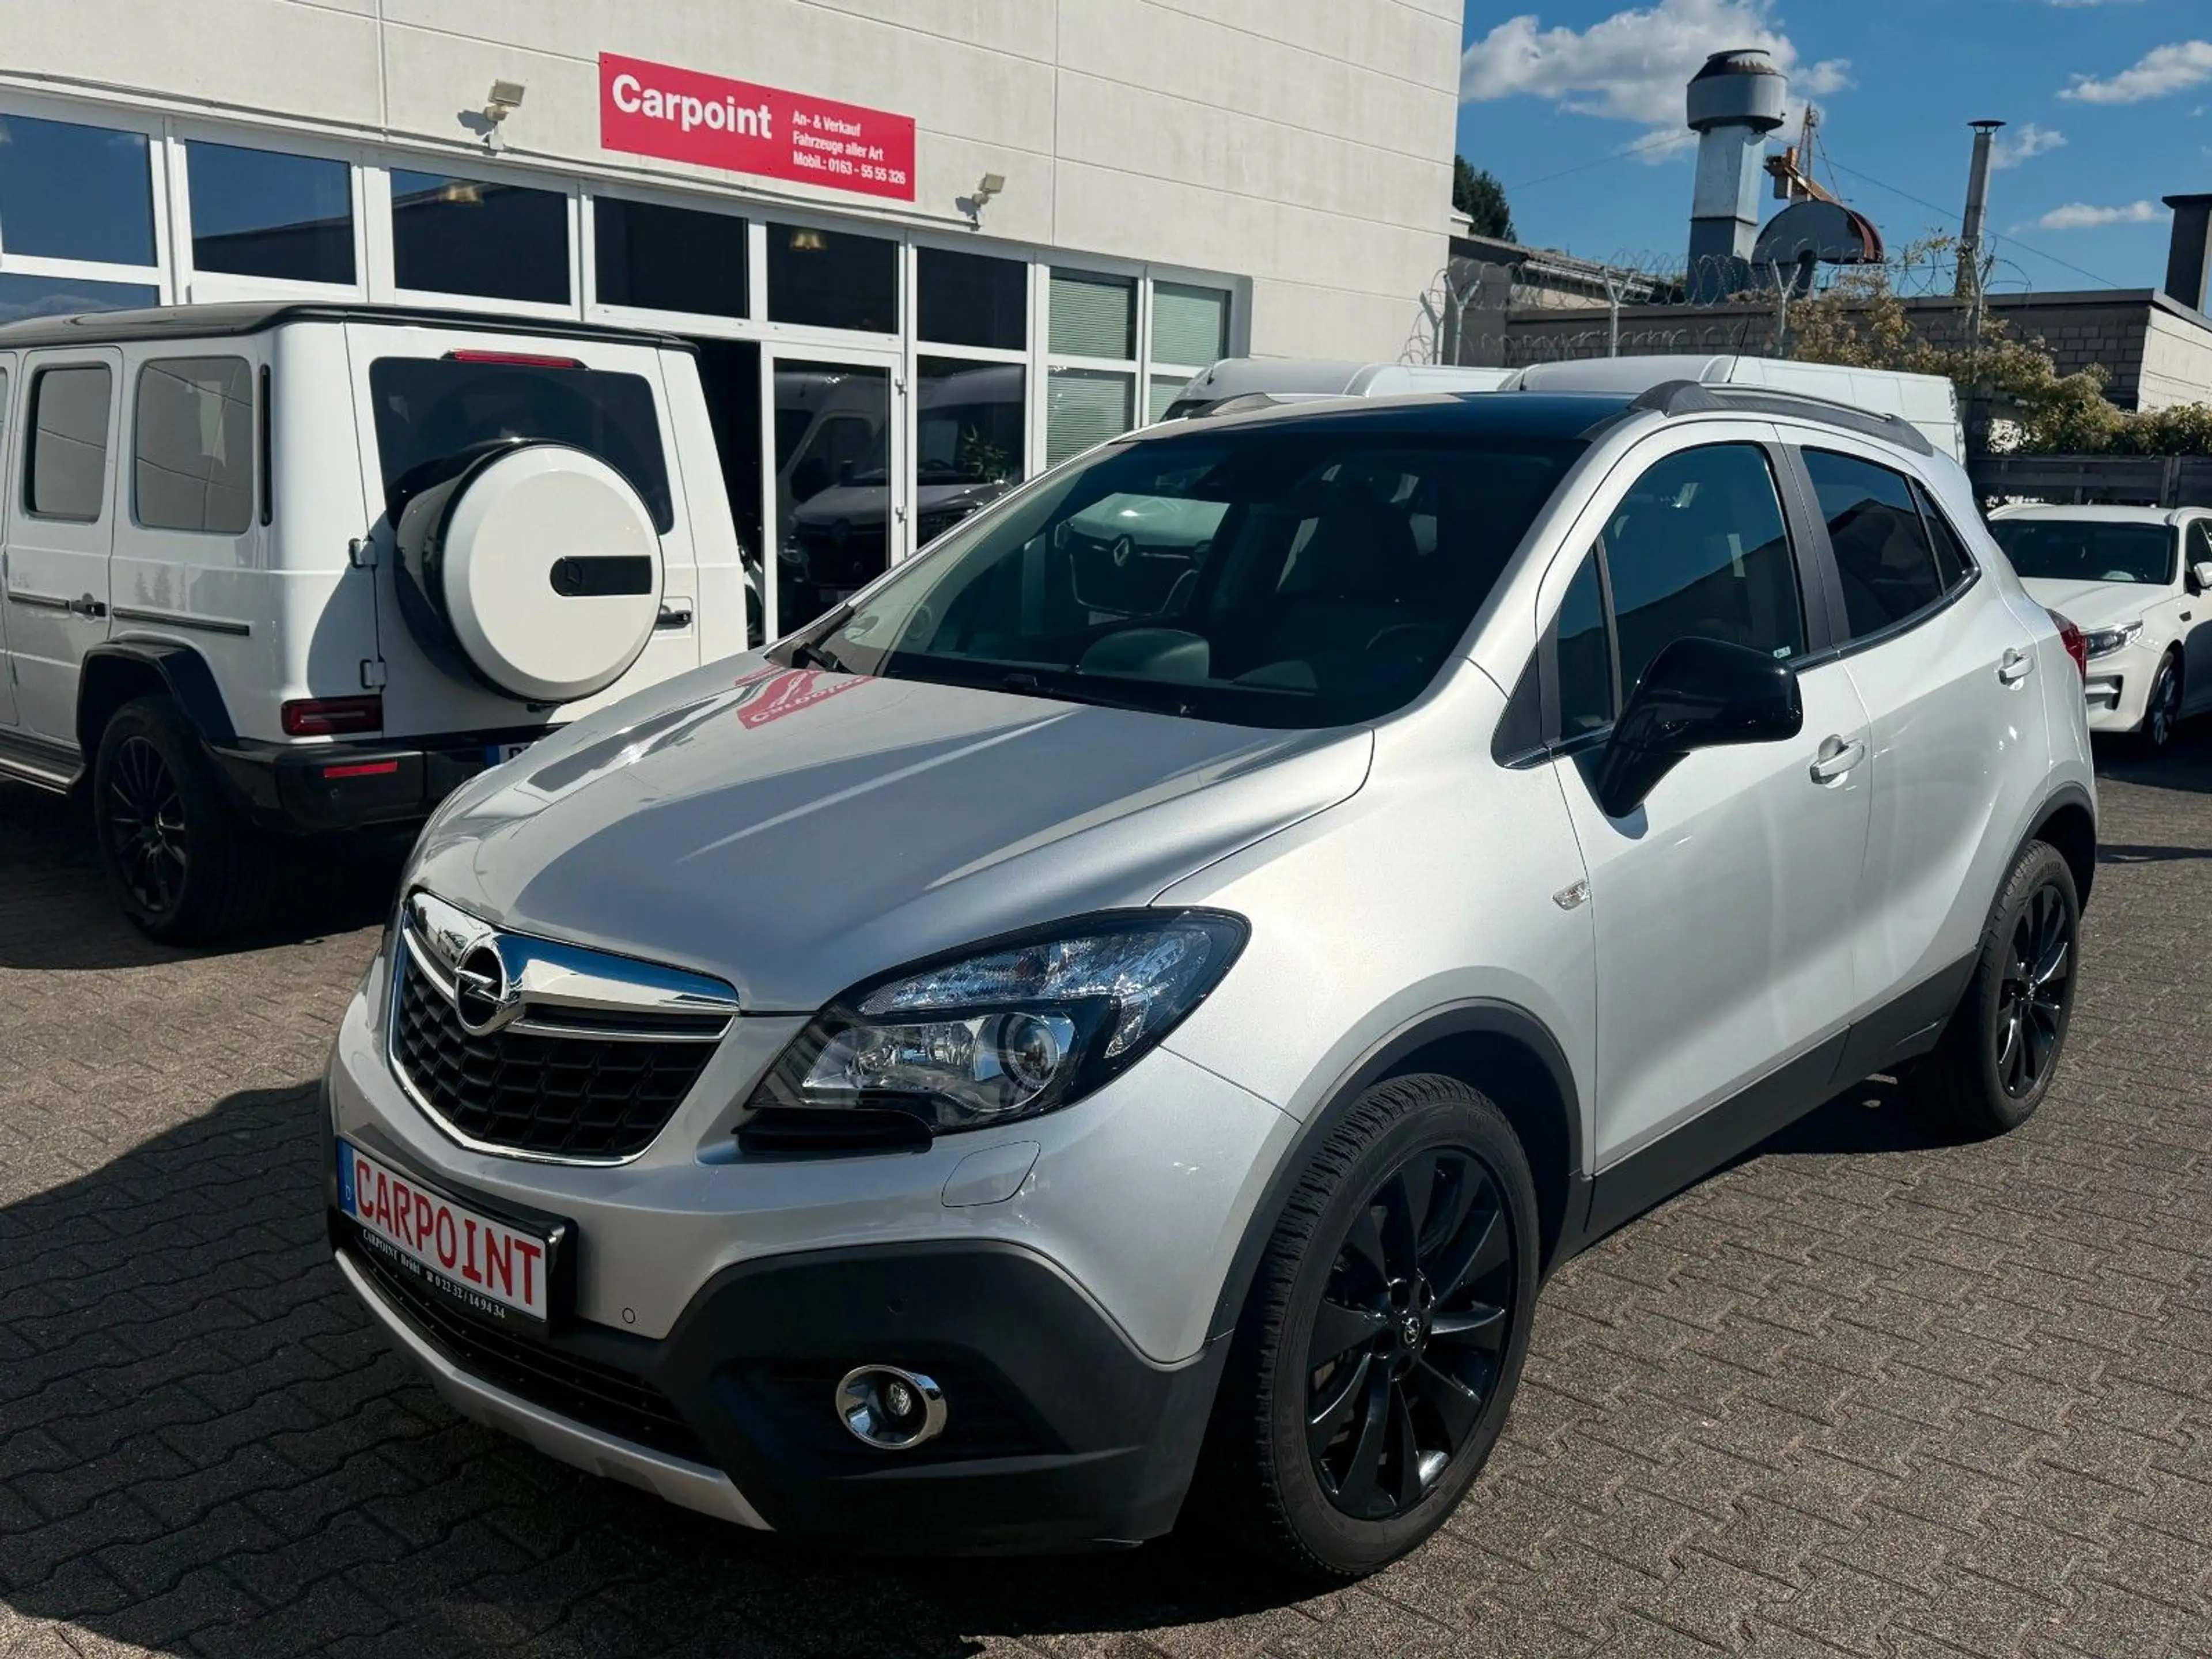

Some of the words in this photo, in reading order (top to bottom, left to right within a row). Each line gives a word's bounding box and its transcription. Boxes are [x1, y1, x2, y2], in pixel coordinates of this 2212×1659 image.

[612, 74, 772, 139] Carpoint
[793, 110, 810, 125] An-
[813, 114, 821, 130] &
[823, 116, 861, 137] Verkauf
[793, 130, 844, 156] Fahrzeuge
[845, 142, 867, 158] aller
[869, 146, 884, 161] Art
[828, 158, 853, 175] 0163
[356, 1158, 541, 1306] CARPOINT
[363, 1228, 398, 1262] CARPOINT
